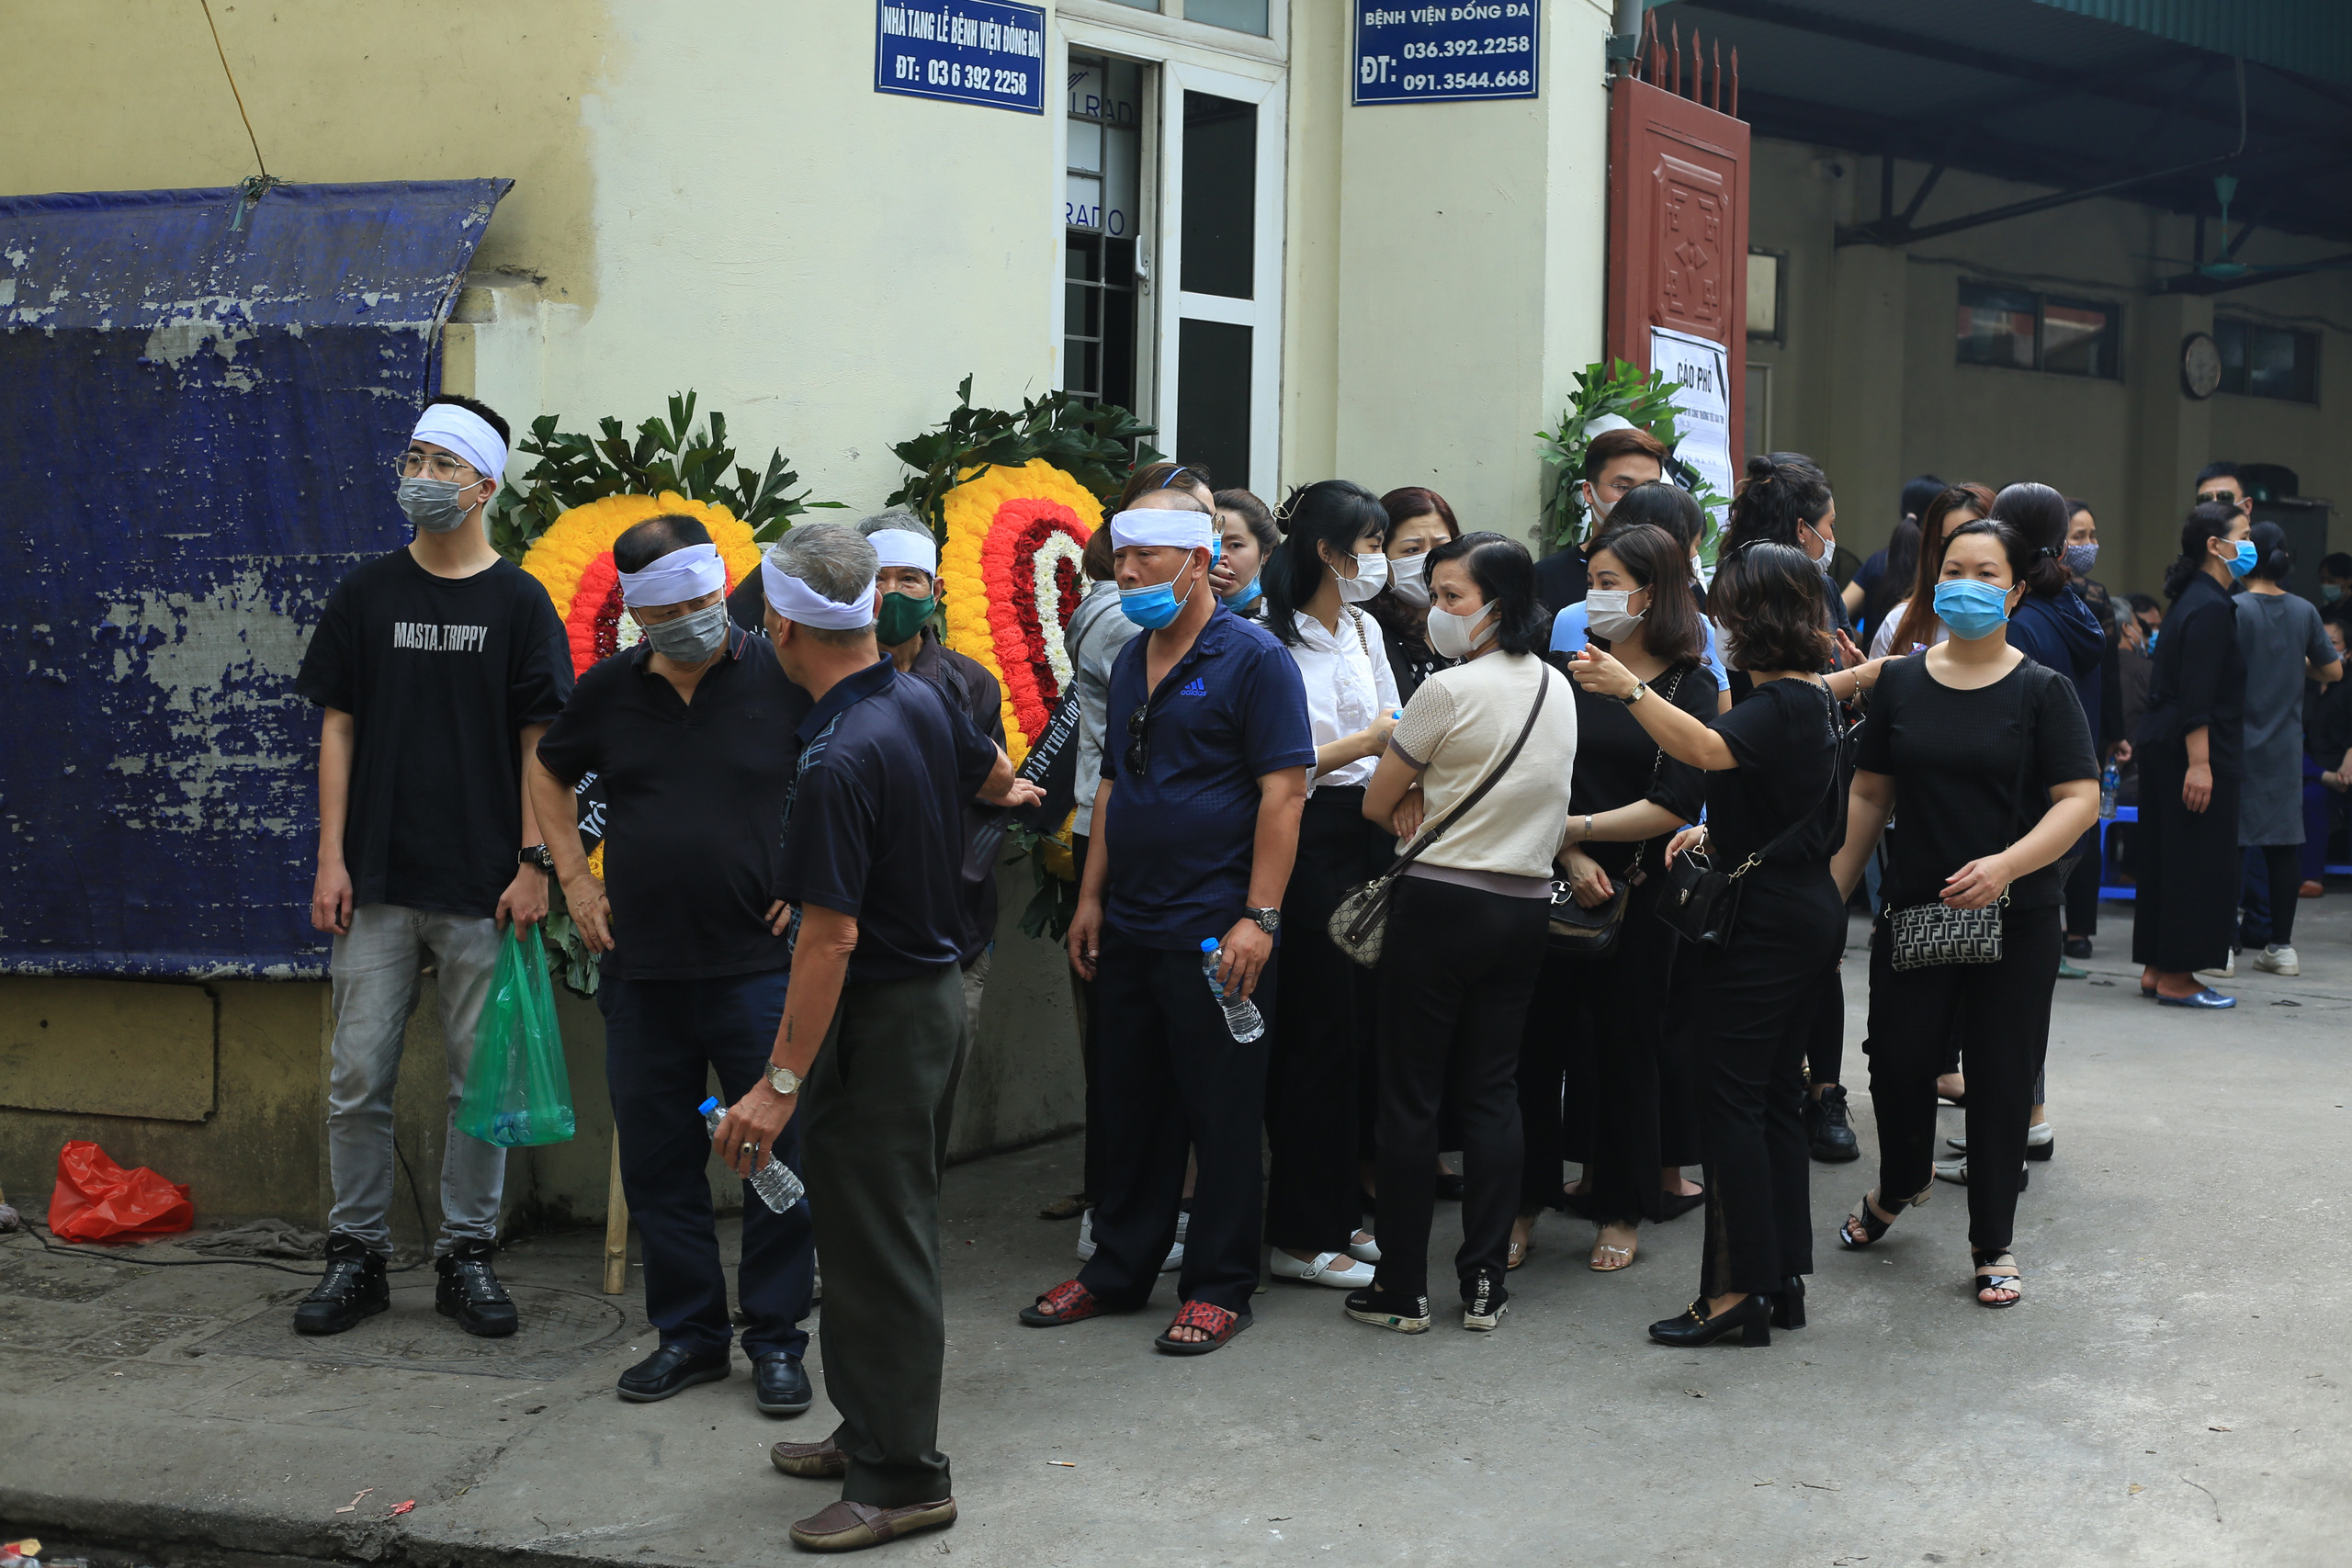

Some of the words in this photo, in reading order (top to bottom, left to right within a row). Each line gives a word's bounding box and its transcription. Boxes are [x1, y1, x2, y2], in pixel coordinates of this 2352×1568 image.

[1365, 9, 1406, 28] BỆNH
[1410, 6, 1446, 26] VIỆN
[1451, 0, 1502, 21] ĐỐNG
[1506, 3, 1531, 17] ĐA
[884, 3, 906, 37] NHÀ
[908, 9, 934, 41] TANG
[936, 5, 949, 43] LỄ
[951, 11, 978, 51] BỆNH
[979, 17, 1001, 56] VIỆN
[1003, 15, 1027, 57] ĐỐNG
[1027, 29, 1040, 59] ĐA
[1404, 35, 1530, 60] 036.392.2258
[895, 54, 921, 82] ĐT:
[964, 64, 991, 91] 392
[994, 69, 1027, 96] 2258
[1361, 55, 1396, 85] ĐT:
[1403, 69, 1530, 91] 091.3544.668
[1677, 358, 1695, 390] CÁO
[1697, 364, 1713, 394] PHÓ
[393, 622, 488, 653] MASTA.TRIPPY
[1023, 755, 1052, 783] TẬP
